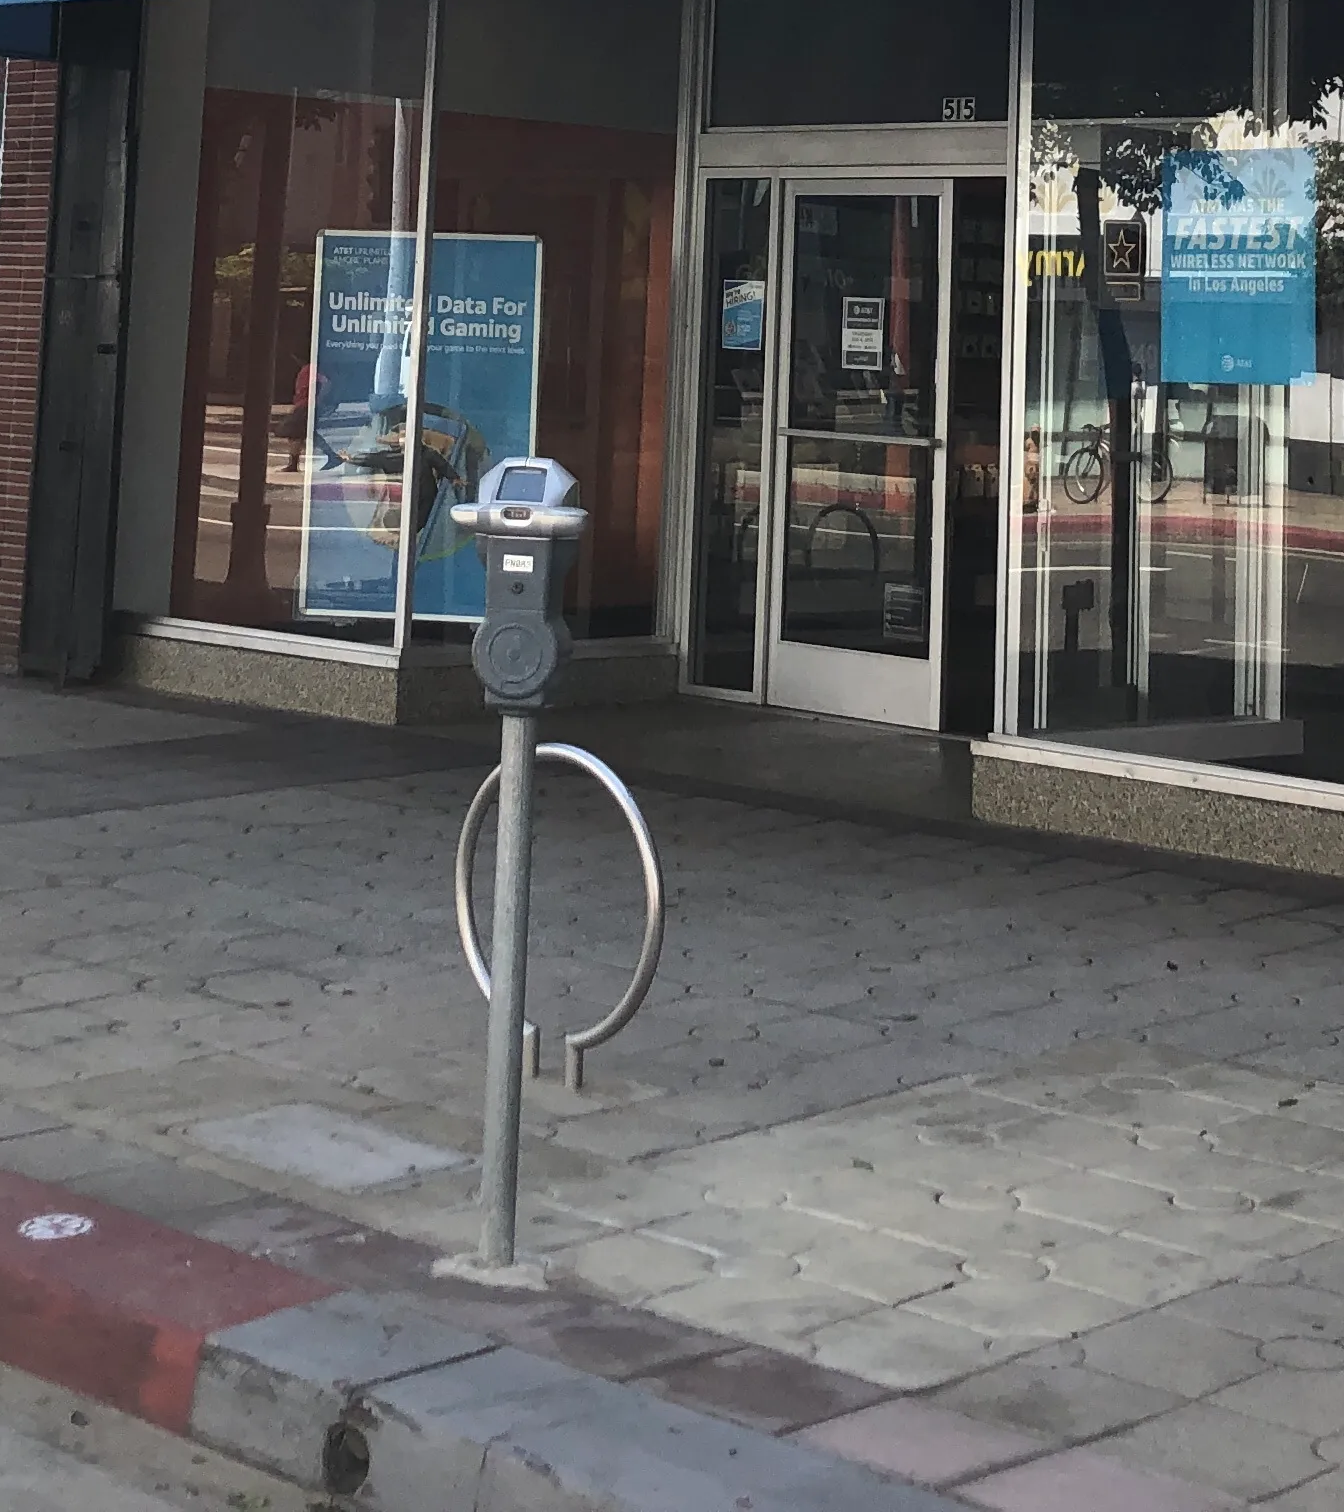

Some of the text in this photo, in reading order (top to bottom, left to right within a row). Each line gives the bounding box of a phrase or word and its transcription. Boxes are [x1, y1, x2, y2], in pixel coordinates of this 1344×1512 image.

[944, 98, 974, 120] 515
[1259, 197, 1285, 213] THE
[1173, 216, 1305, 250] FASTEST
[1171, 253, 1306, 269] WIRELESS NETWORK
[1205, 276, 1227, 292] Los
[1230, 276, 1284, 296] Angeles
[329, 291, 526, 316] Unlimite Data For
[725, 291, 756, 308] HIRING!
[332, 314, 522, 343] Unlimitd Gaming
